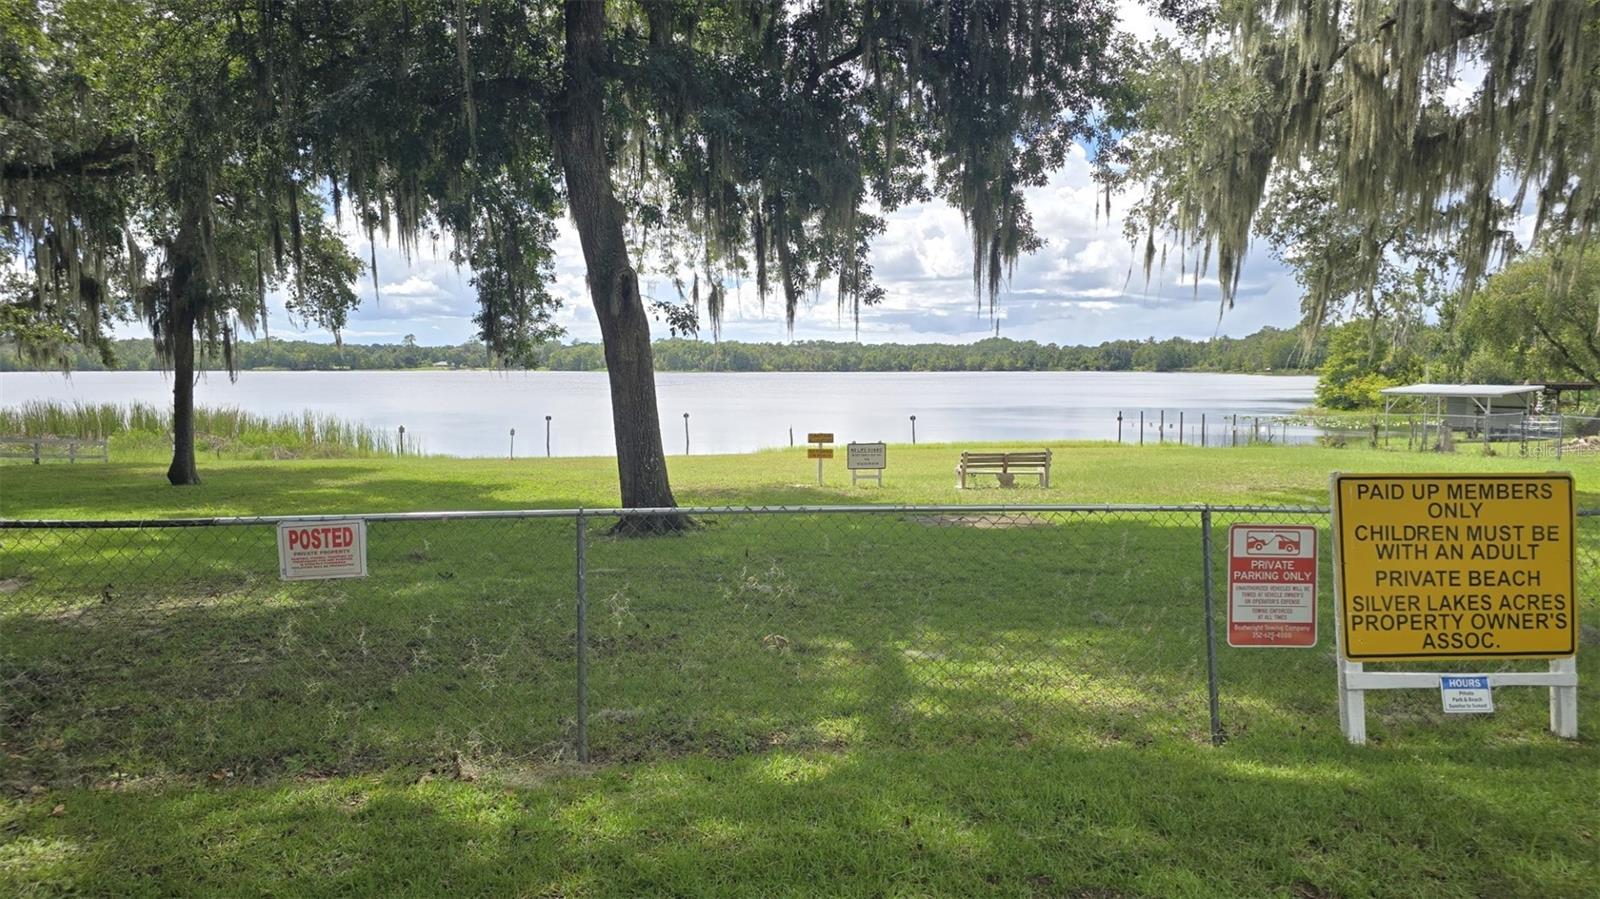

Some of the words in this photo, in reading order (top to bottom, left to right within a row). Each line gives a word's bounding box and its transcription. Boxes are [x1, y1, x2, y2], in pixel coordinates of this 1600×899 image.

[1357, 483, 1404, 500] PAID
[1411, 483, 1440, 500] UP
[1447, 483, 1553, 500] MEMBERS
[1427, 502, 1483, 519] ONLY
[288, 527, 354, 551] POSTED
[1354, 525, 1459, 542] CHILDREN
[1466, 525, 1525, 542] MUST
[1532, 525, 1560, 542] BE
[1375, 543, 1428, 560] WITH
[1435, 543, 1464, 560] AN
[1471, 543, 1540, 560] ADULT
[1251, 560, 1295, 570] PRIVATE
[1233, 571, 1279, 580] PARKING
[1283, 571, 1312, 581] ONLY
[1375, 570, 1461, 587] PRIVATE
[1468, 570, 1541, 587] BEACH
[1352, 596, 1421, 612] SILVER
[1427, 595, 1492, 611] LAKES
[1499, 594, 1566, 610] ACRES
[1351, 614, 1464, 631] PROPERTY
[1471, 613, 1568, 630] OWNER'S
[1422, 632, 1500, 650] ASSOC.
[1449, 679, 1481, 688] HOURS
